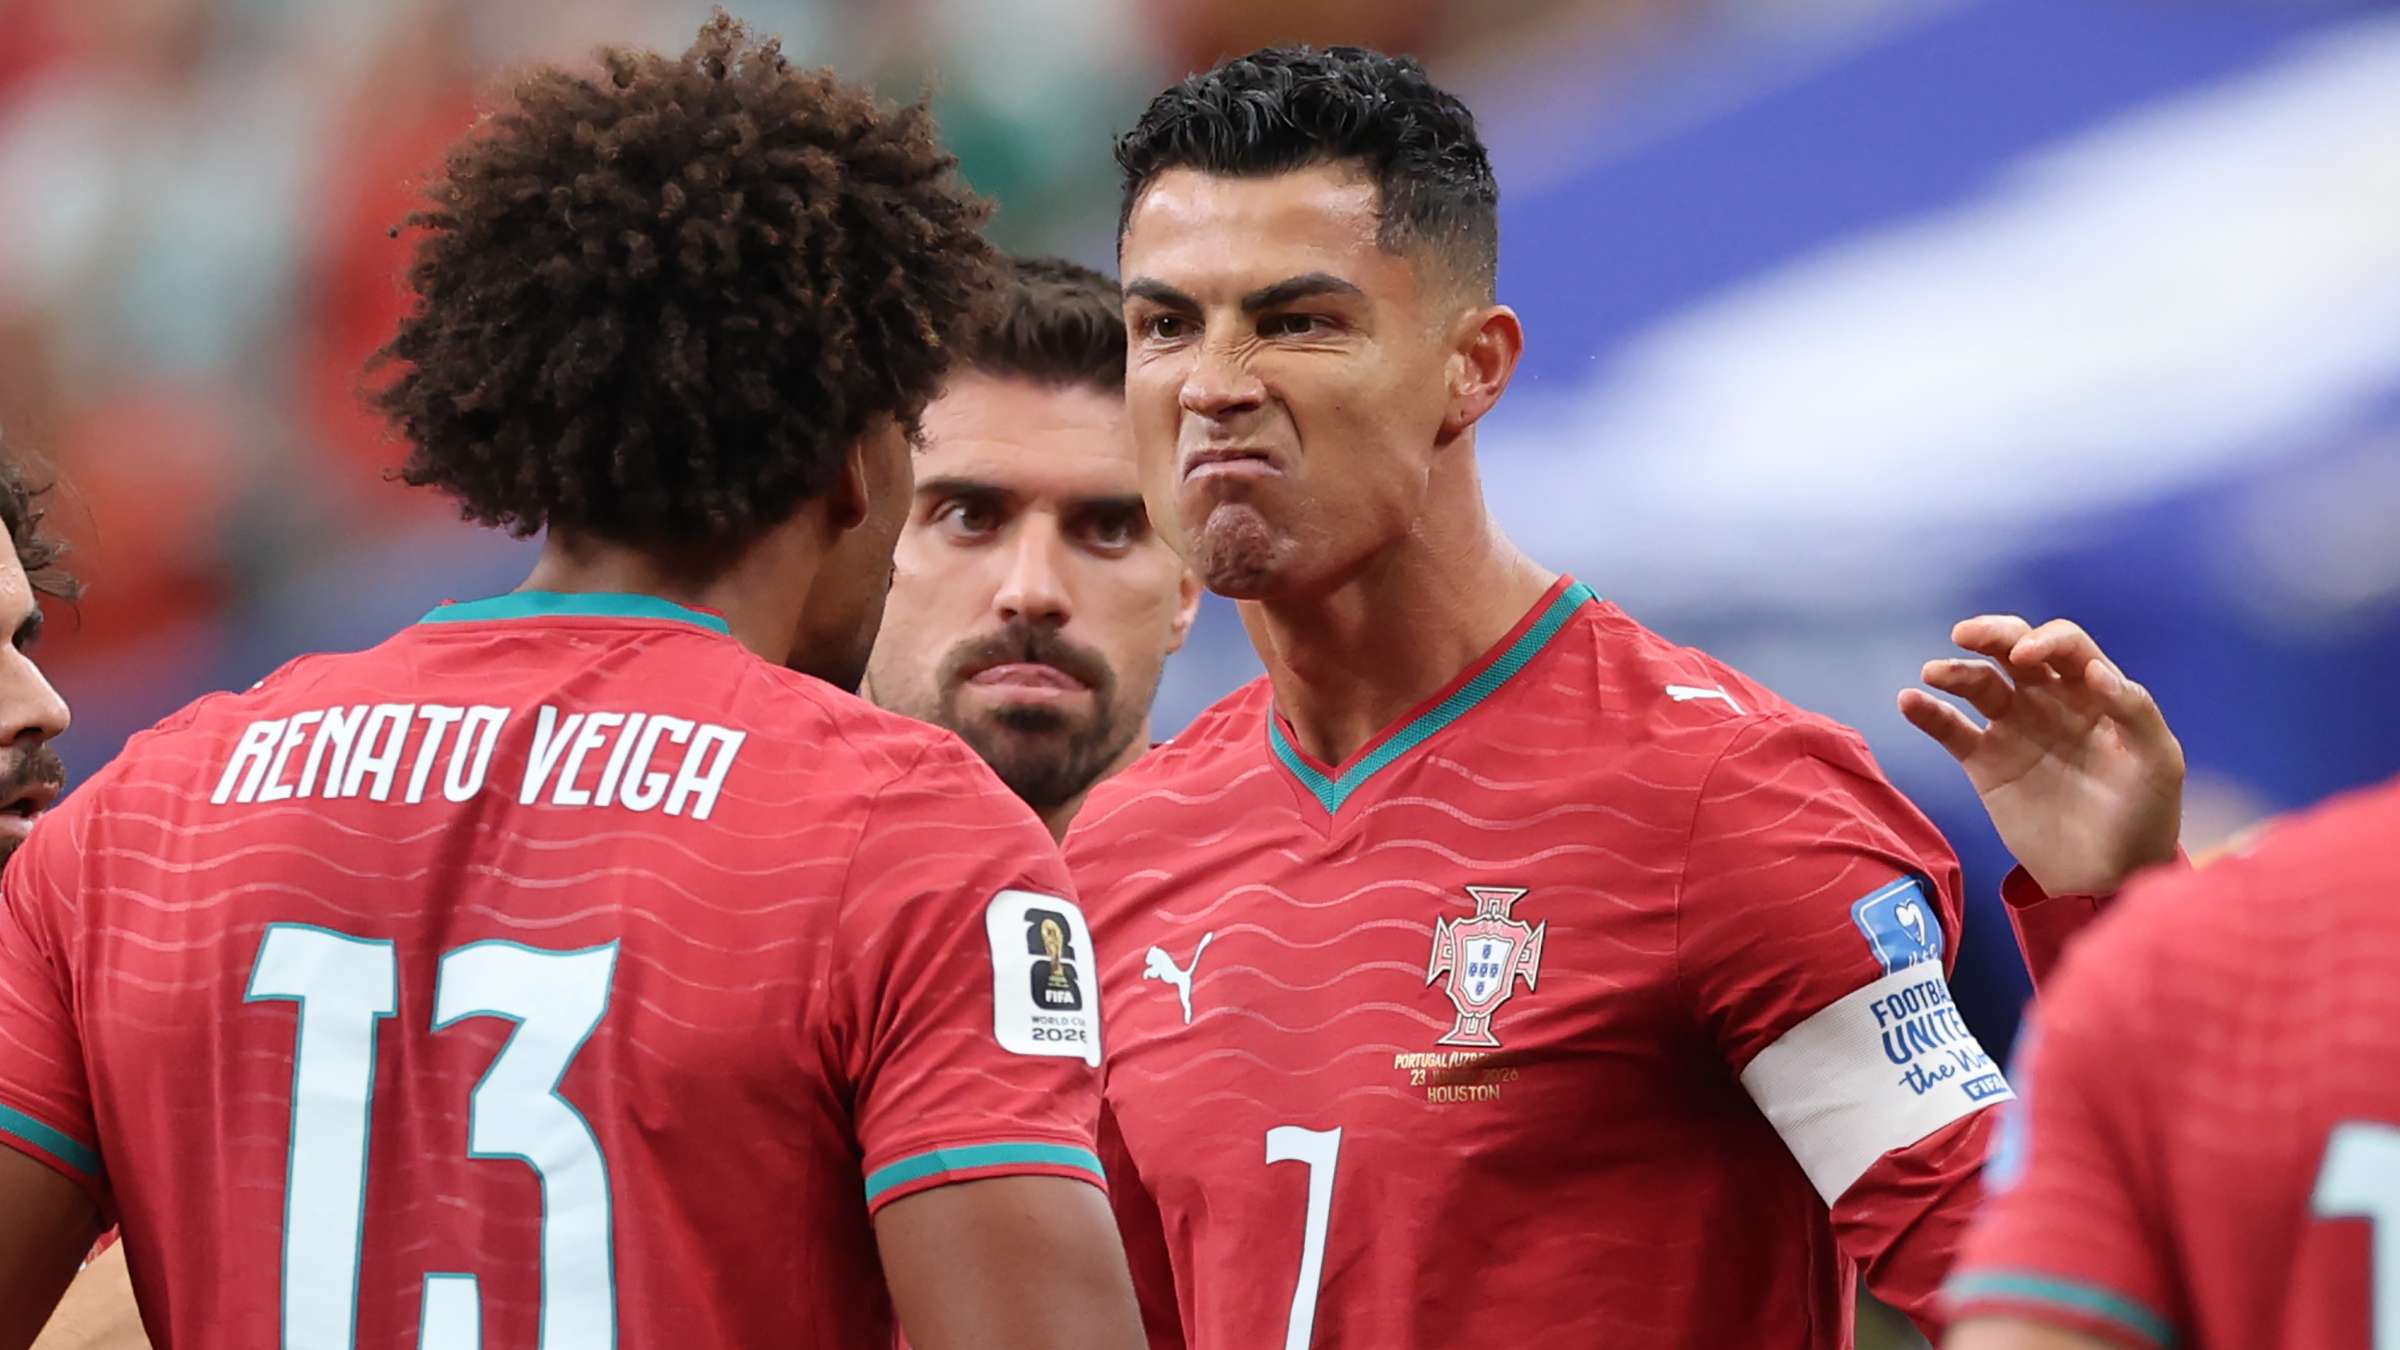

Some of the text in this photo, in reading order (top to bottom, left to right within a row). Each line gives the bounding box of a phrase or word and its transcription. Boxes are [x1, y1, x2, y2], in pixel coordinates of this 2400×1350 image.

[210, 704, 746, 821] RENATO VEIGA
[1045, 989, 1075, 1004] FIFA
[1870, 978, 1951, 1029] FOOTB
[1031, 1016, 1069, 1026] WORLD
[1882, 1008, 1968, 1065] UNITE
[1410, 1069, 1426, 1086] 23
[1427, 1084, 1500, 1103] HOUSTON
[1899, 1063, 1955, 1096] the
[243, 922, 620, 1350] 13
[1264, 1125, 1342, 1350] 7
